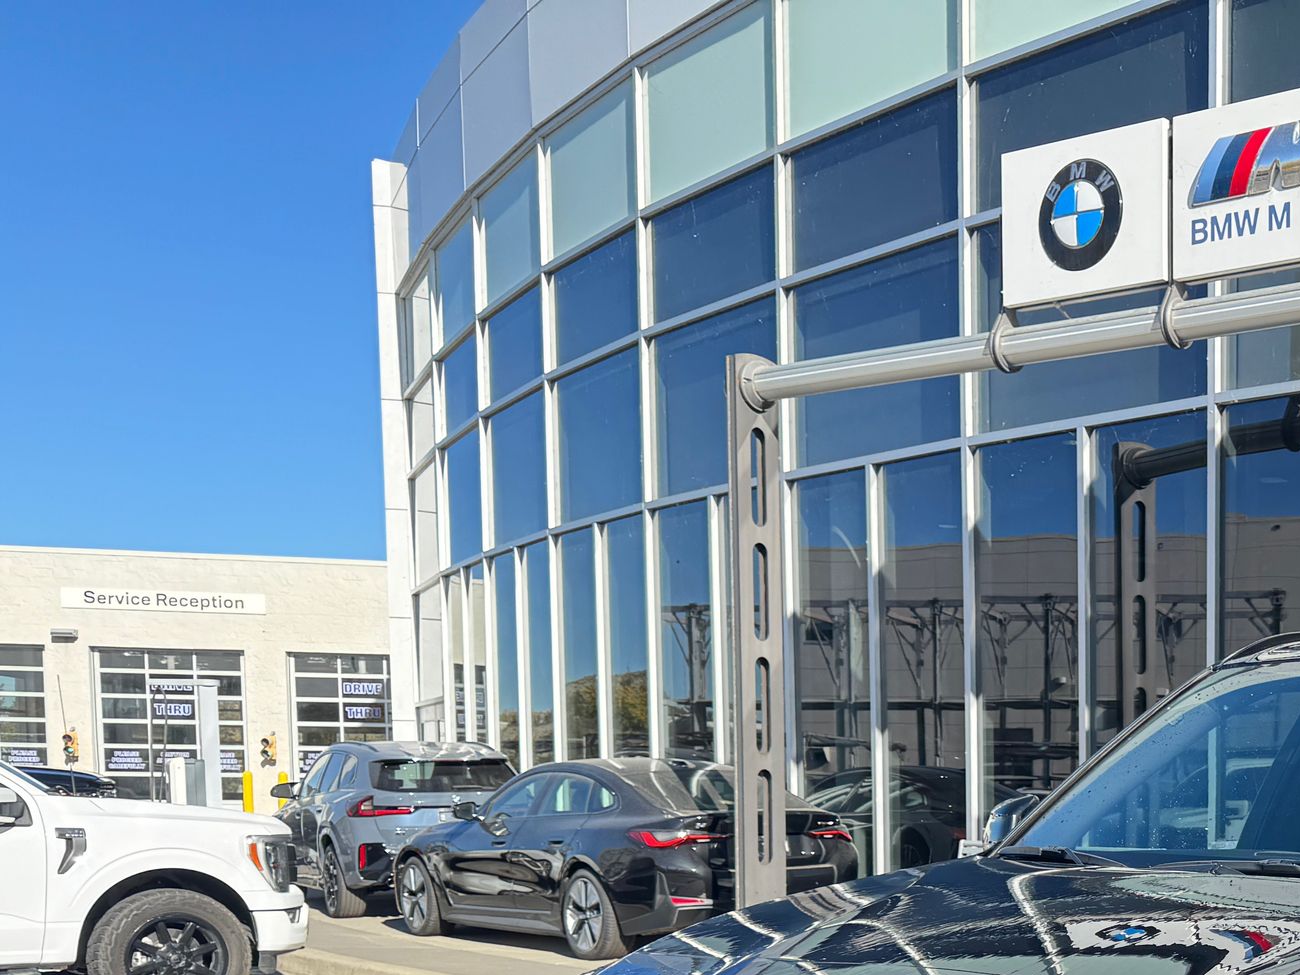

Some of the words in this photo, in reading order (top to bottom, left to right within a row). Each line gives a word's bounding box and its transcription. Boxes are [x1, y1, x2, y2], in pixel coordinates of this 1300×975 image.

[1046, 161, 1115, 203] BMW
[1190, 207, 1260, 246] BMW
[1267, 203, 1292, 231] M
[83, 590, 151, 606] Service
[156, 593, 245, 610] Reception
[343, 682, 382, 695] DRIVE
[154, 703, 192, 717] THRU
[345, 706, 381, 719] THRU
